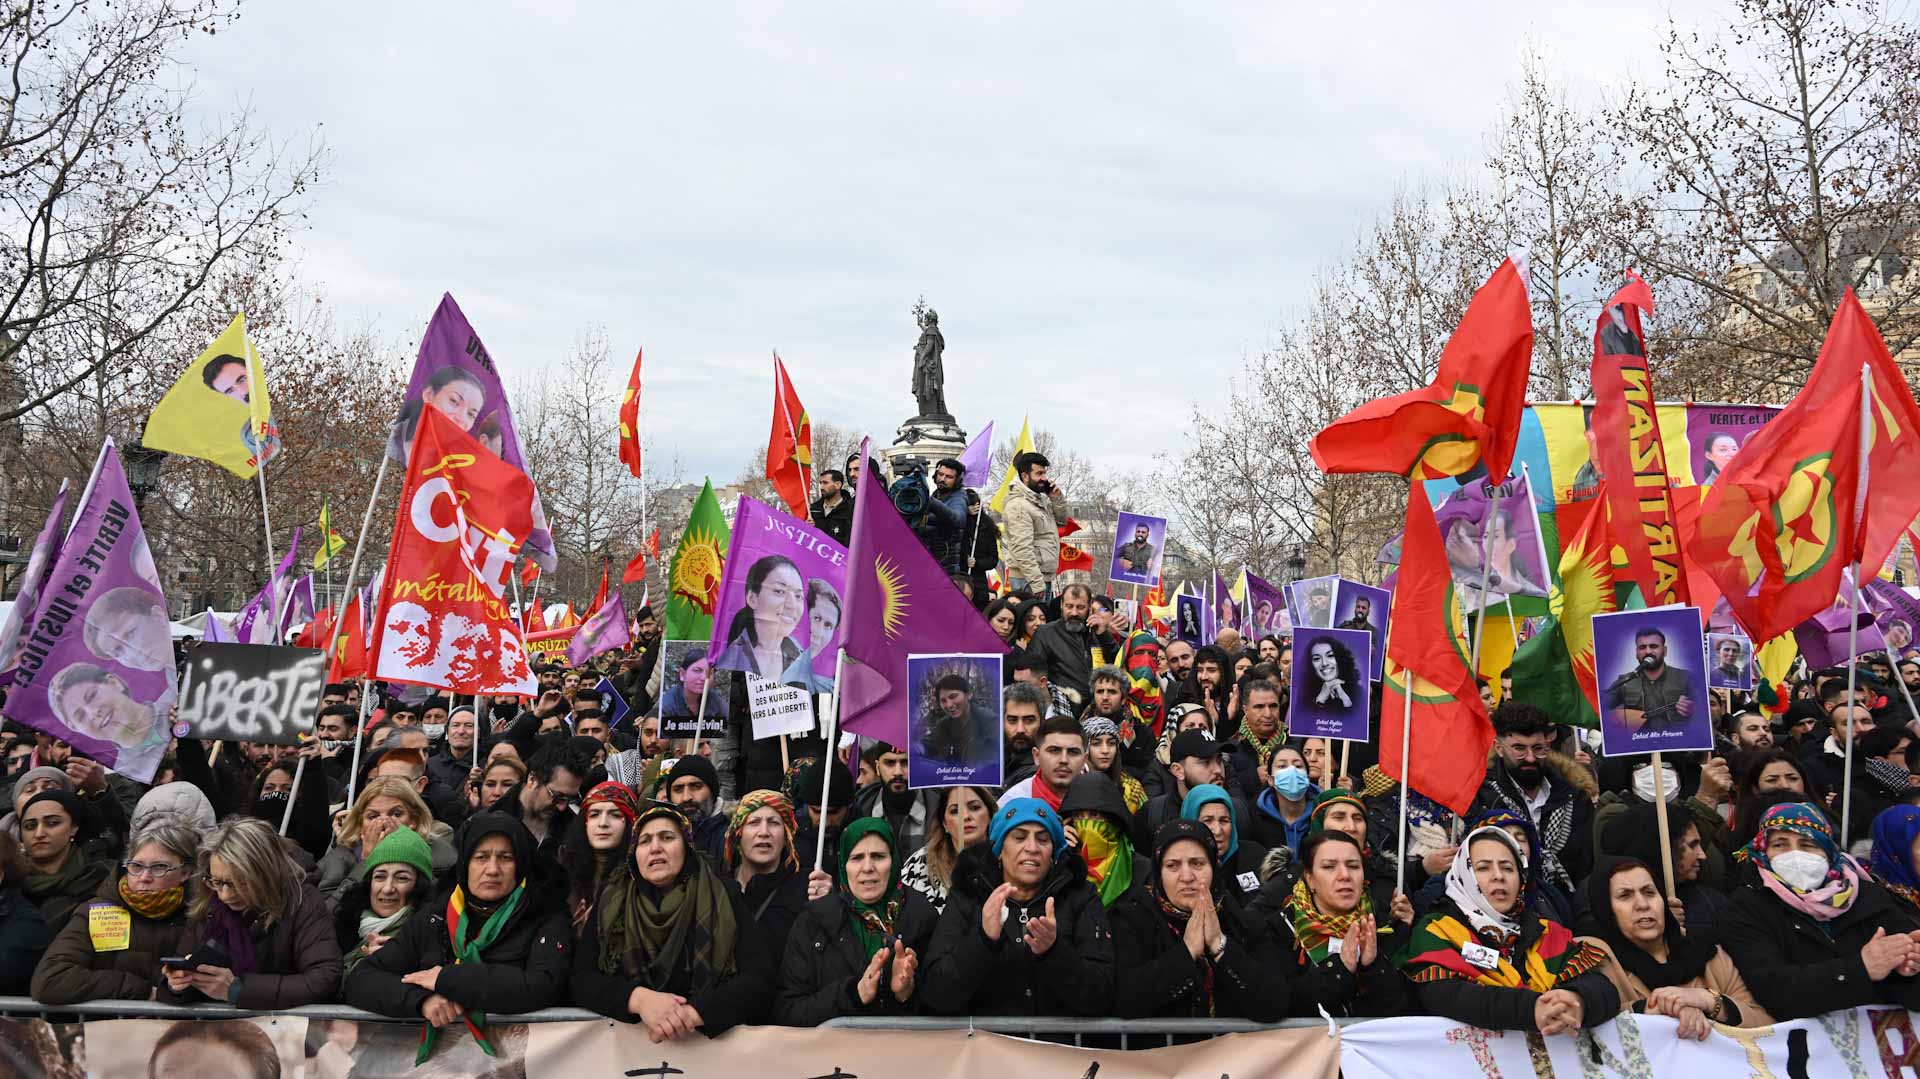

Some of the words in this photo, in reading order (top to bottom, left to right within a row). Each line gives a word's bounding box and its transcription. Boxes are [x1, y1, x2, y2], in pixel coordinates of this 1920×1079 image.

[764, 514, 845, 567] JUSTICE
[755, 684, 764, 693] LA
[755, 696, 768, 706] DES
[768, 690, 798, 704] KURDES
[752, 710, 767, 720] VERS
[767, 707, 777, 717] LA
[664, 719, 677, 731] Je
[677, 719, 698, 731] suis
